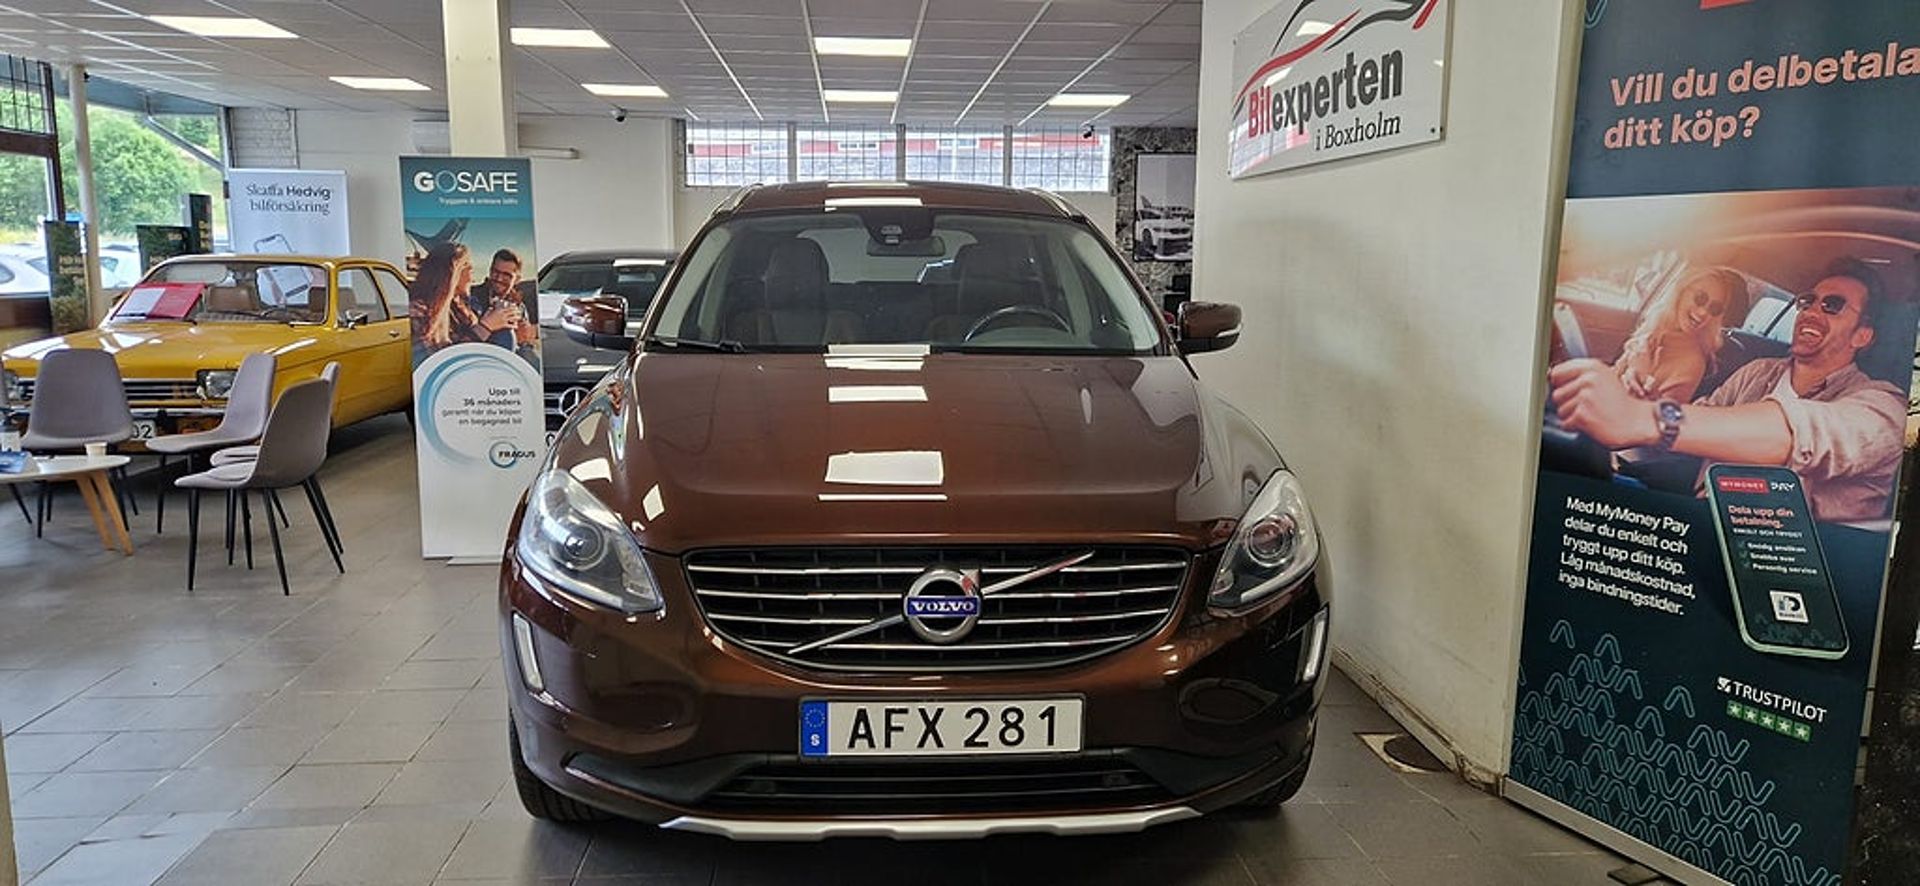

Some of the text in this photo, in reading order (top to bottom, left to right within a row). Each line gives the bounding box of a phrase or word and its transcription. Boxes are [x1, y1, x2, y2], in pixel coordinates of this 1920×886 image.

[1249, 49, 1404, 138] Bilexperten
[1610, 42, 1920, 106] Vill du delbetala
[1315, 111, 1401, 150] i Boxholm
[1603, 106, 1761, 149] ditt köp?
[286, 185, 331, 201] Hedvig
[413, 169, 519, 193] GOSAFE
[248, 199, 331, 216] bilförsäkring
[477, 398, 521, 407] månaders
[488, 387, 508, 397] Upp
[1566, 496, 1690, 537] Med MyMoney Pay
[1753, 507, 1774, 518] upp
[1562, 534, 1686, 576] tryggt upp ditt köp.
[1564, 516, 1688, 555] delar du enkelt och
[1558, 569, 1685, 616] inga bindningstider.
[1560, 551, 1697, 600] Låg månadskostnad,
[910, 600, 976, 612] VOLVO
[1733, 681, 1828, 723] TRUSTPILOT
[810, 733, 821, 746] S
[847, 705, 1057, 750] AFX 281
